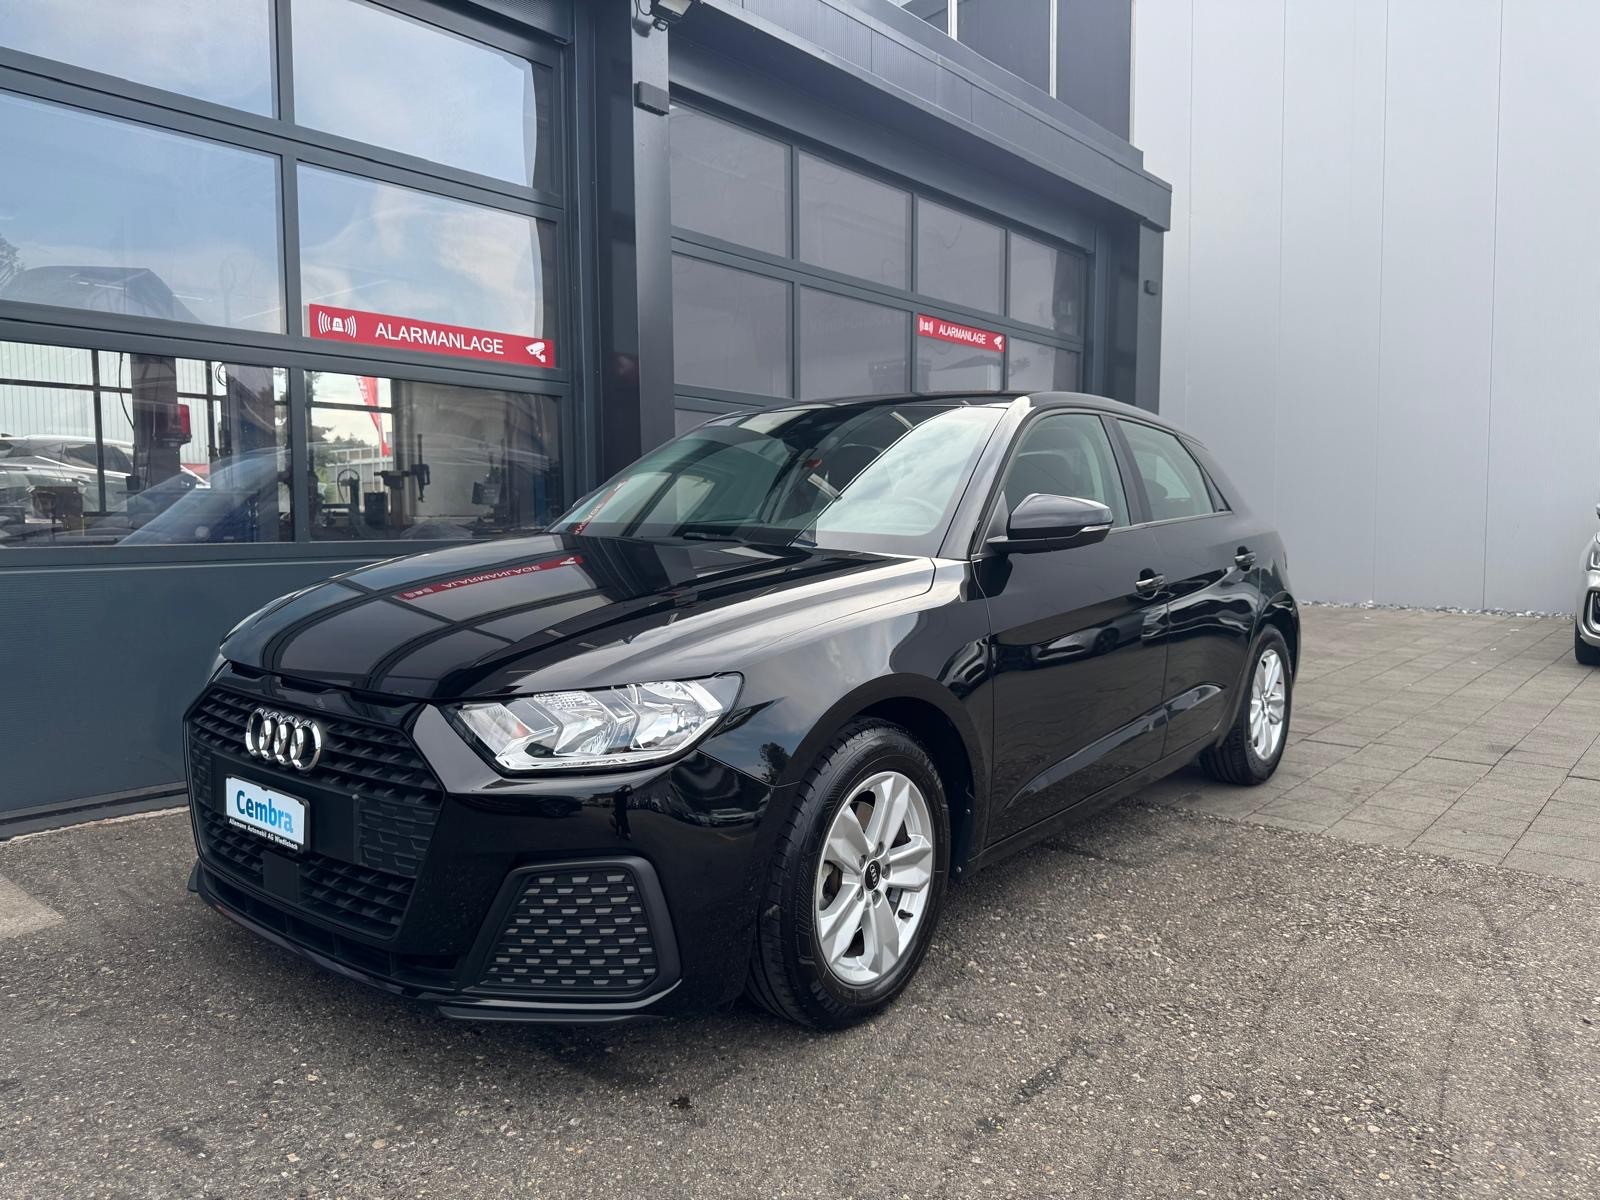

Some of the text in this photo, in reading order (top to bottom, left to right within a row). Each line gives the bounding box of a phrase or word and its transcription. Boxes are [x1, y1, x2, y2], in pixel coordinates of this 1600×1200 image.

[375, 322, 504, 355] ALARMANLAGE
[938, 324, 986, 345] ALARMANLAGE
[236, 790, 294, 833] Cembra
[267, 832, 274, 841] AG
